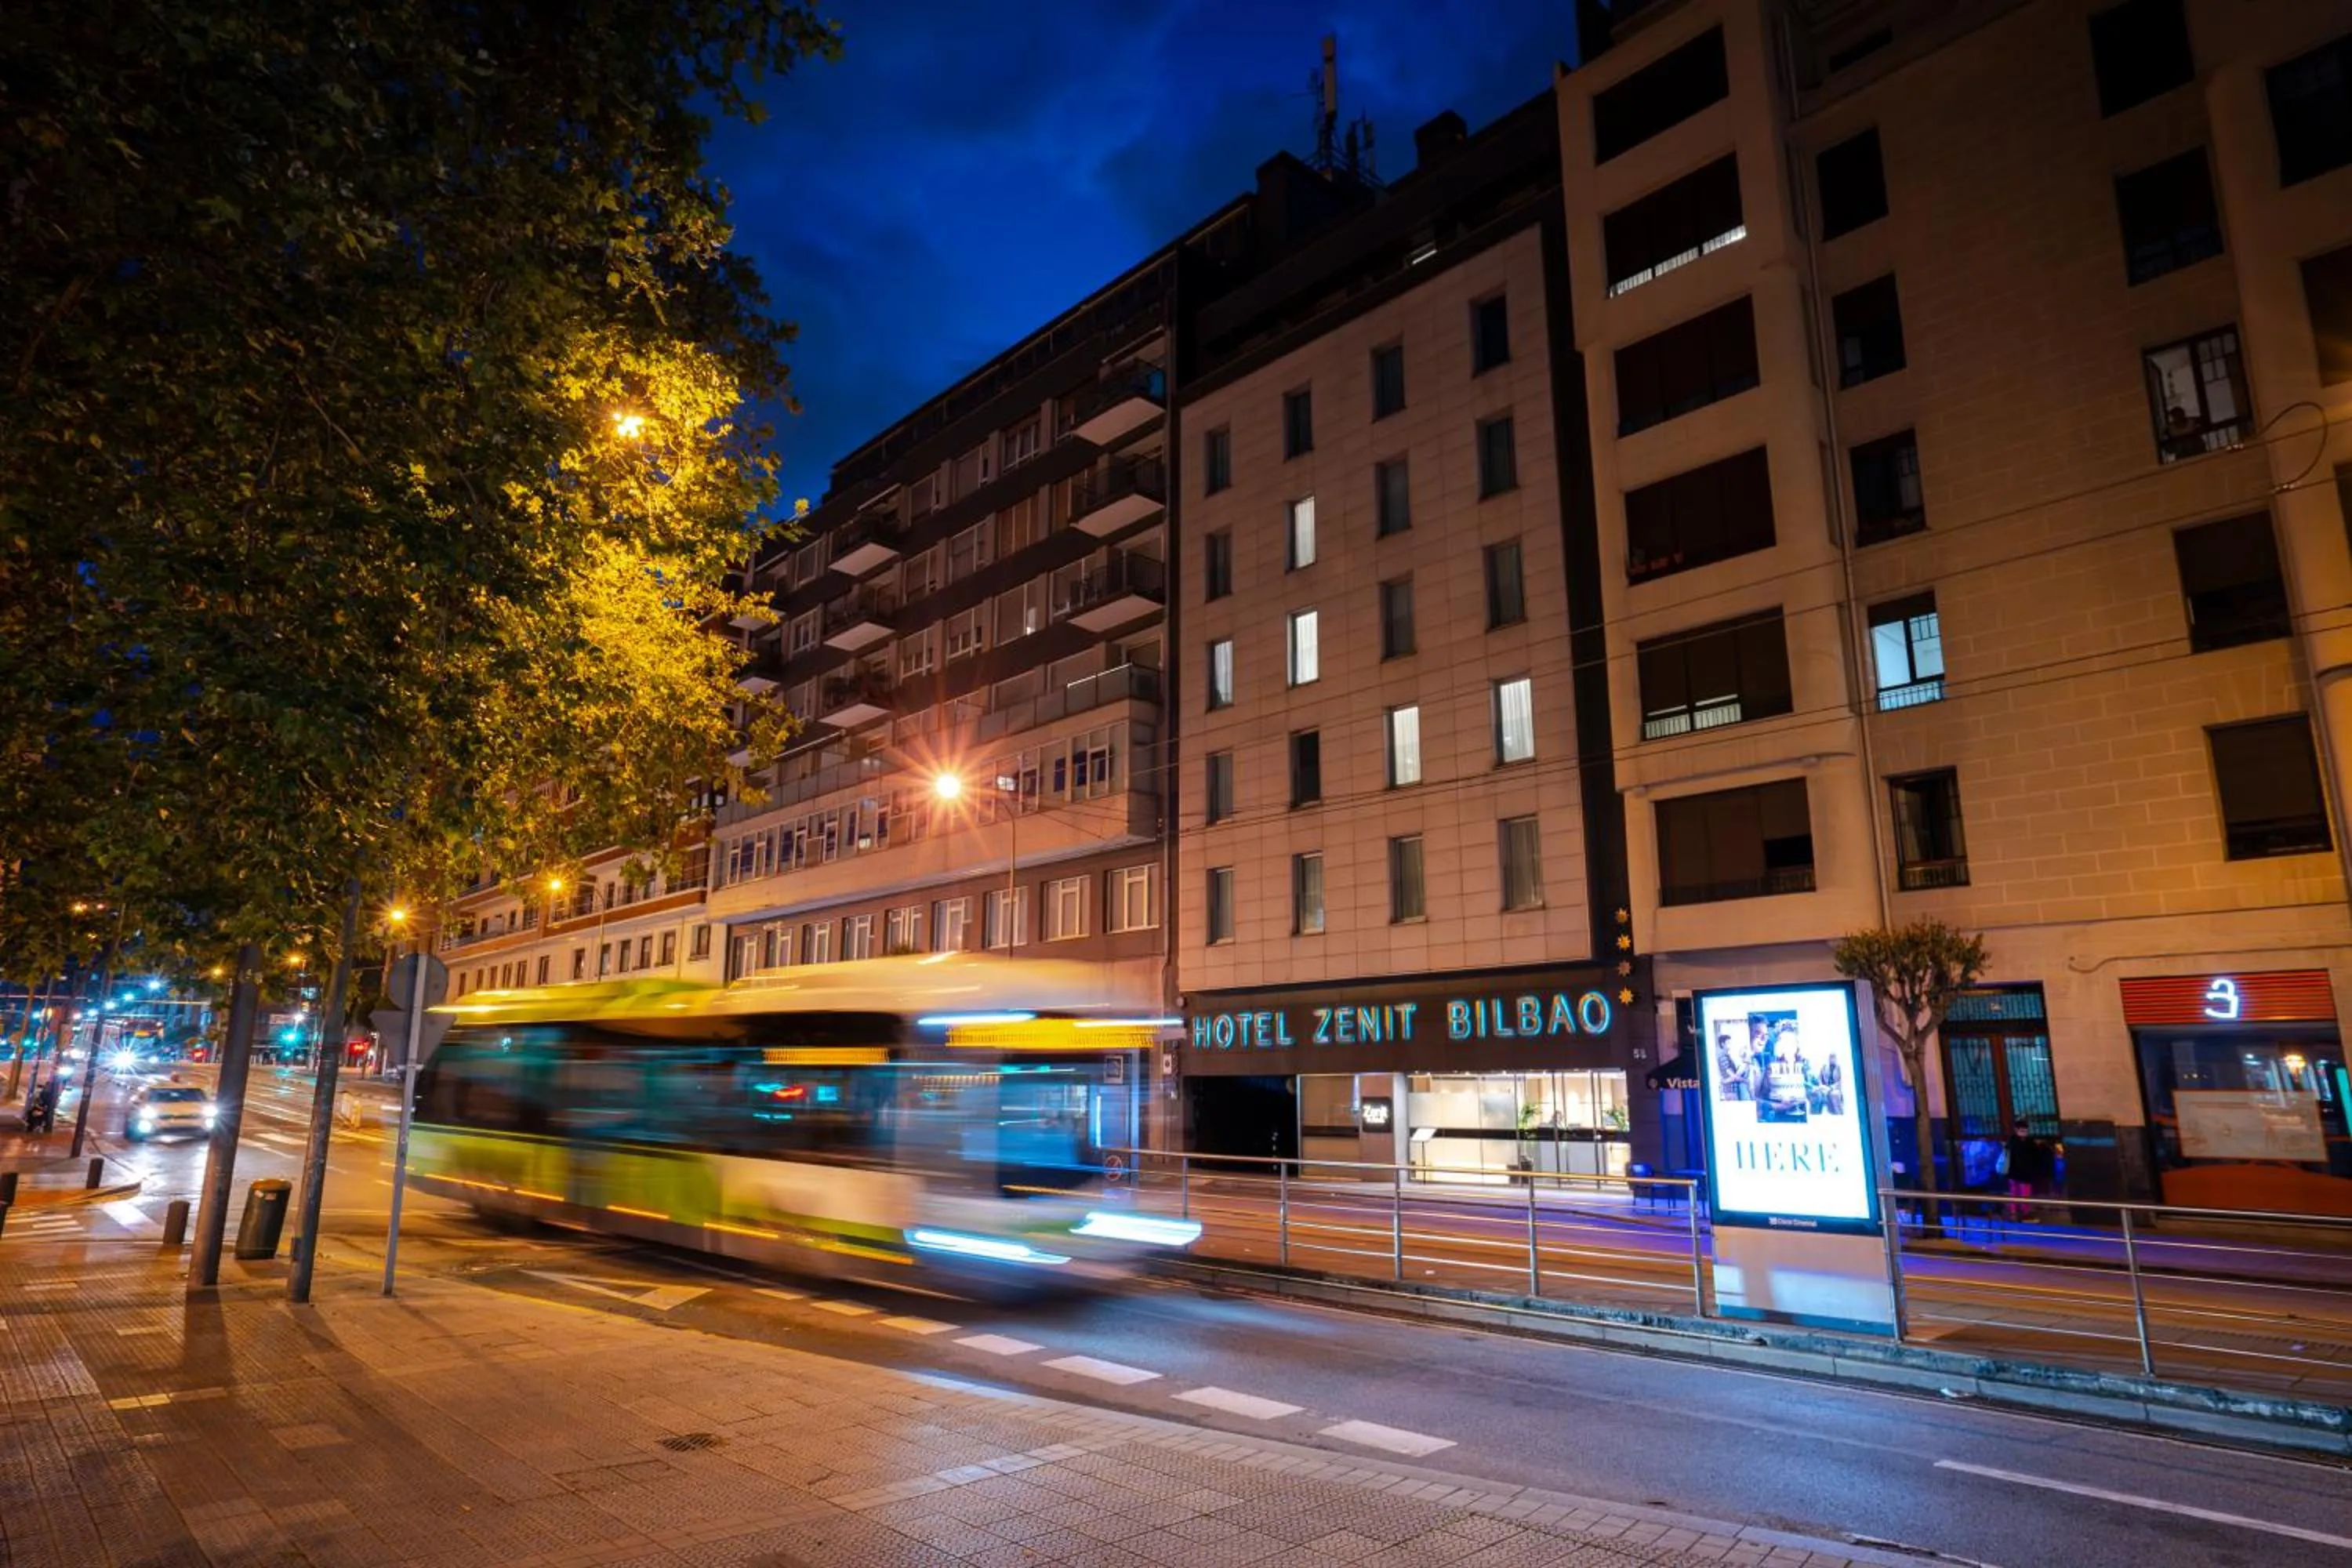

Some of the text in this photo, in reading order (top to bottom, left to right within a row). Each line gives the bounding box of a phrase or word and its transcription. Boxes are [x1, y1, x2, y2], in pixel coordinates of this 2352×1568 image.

[1192, 1012, 1294, 1048] HOTEL
[1312, 1003, 1417, 1044] ZENIT
[1446, 991, 1610, 1040] BILBAO
[1736, 1141, 1839, 1173] HERE
